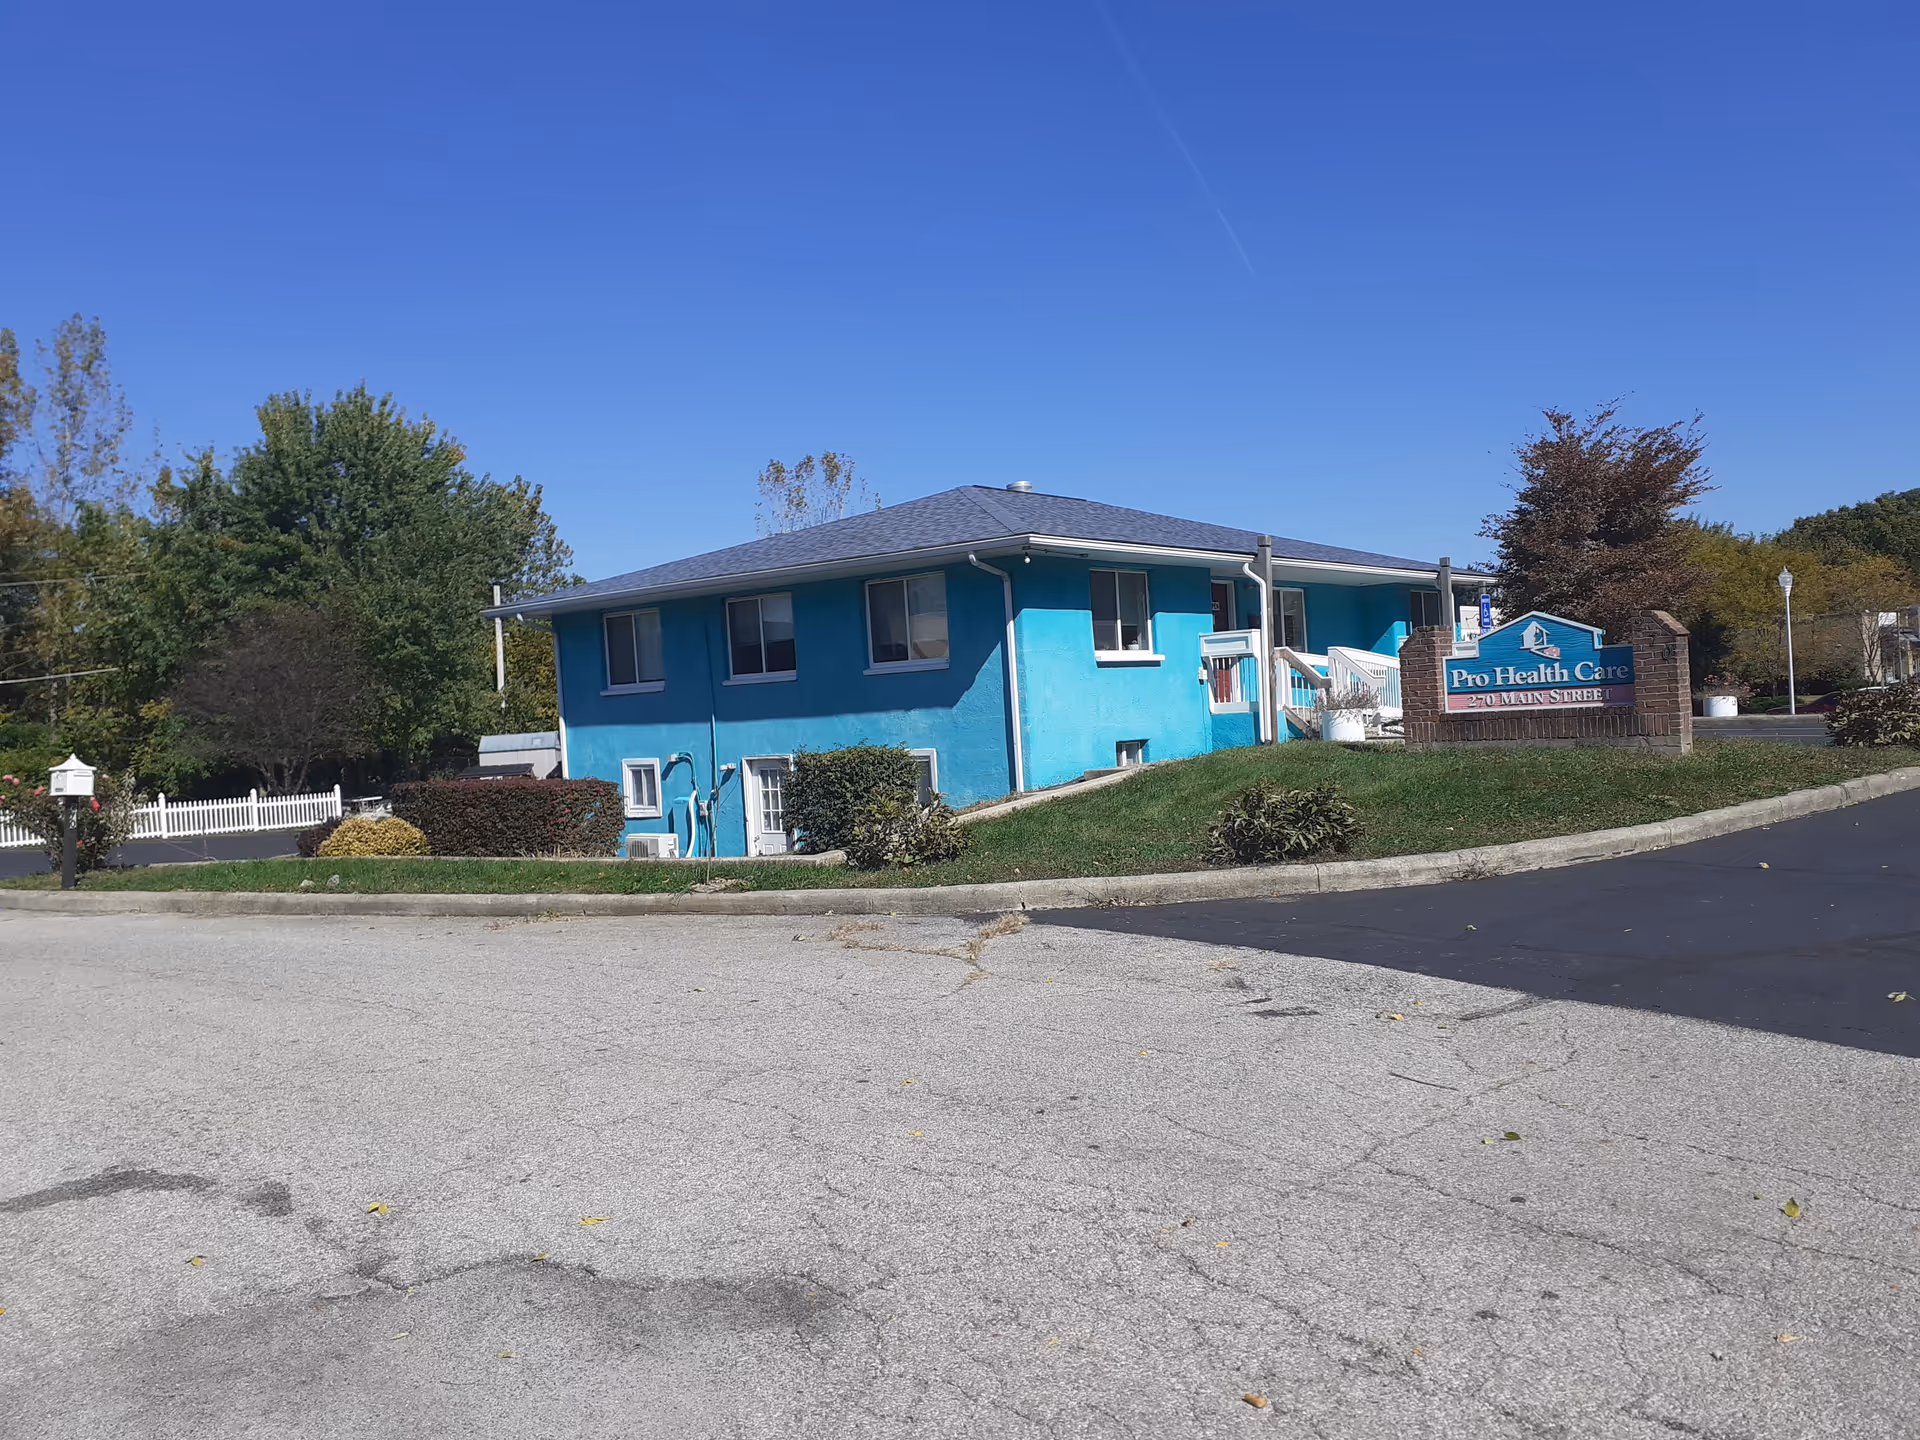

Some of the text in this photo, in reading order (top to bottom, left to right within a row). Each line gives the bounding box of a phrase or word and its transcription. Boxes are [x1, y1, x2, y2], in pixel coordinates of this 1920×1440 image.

[1450, 661, 1629, 688] Pro Health Care
[1467, 688, 1612, 708] 270 MAIN STREET
